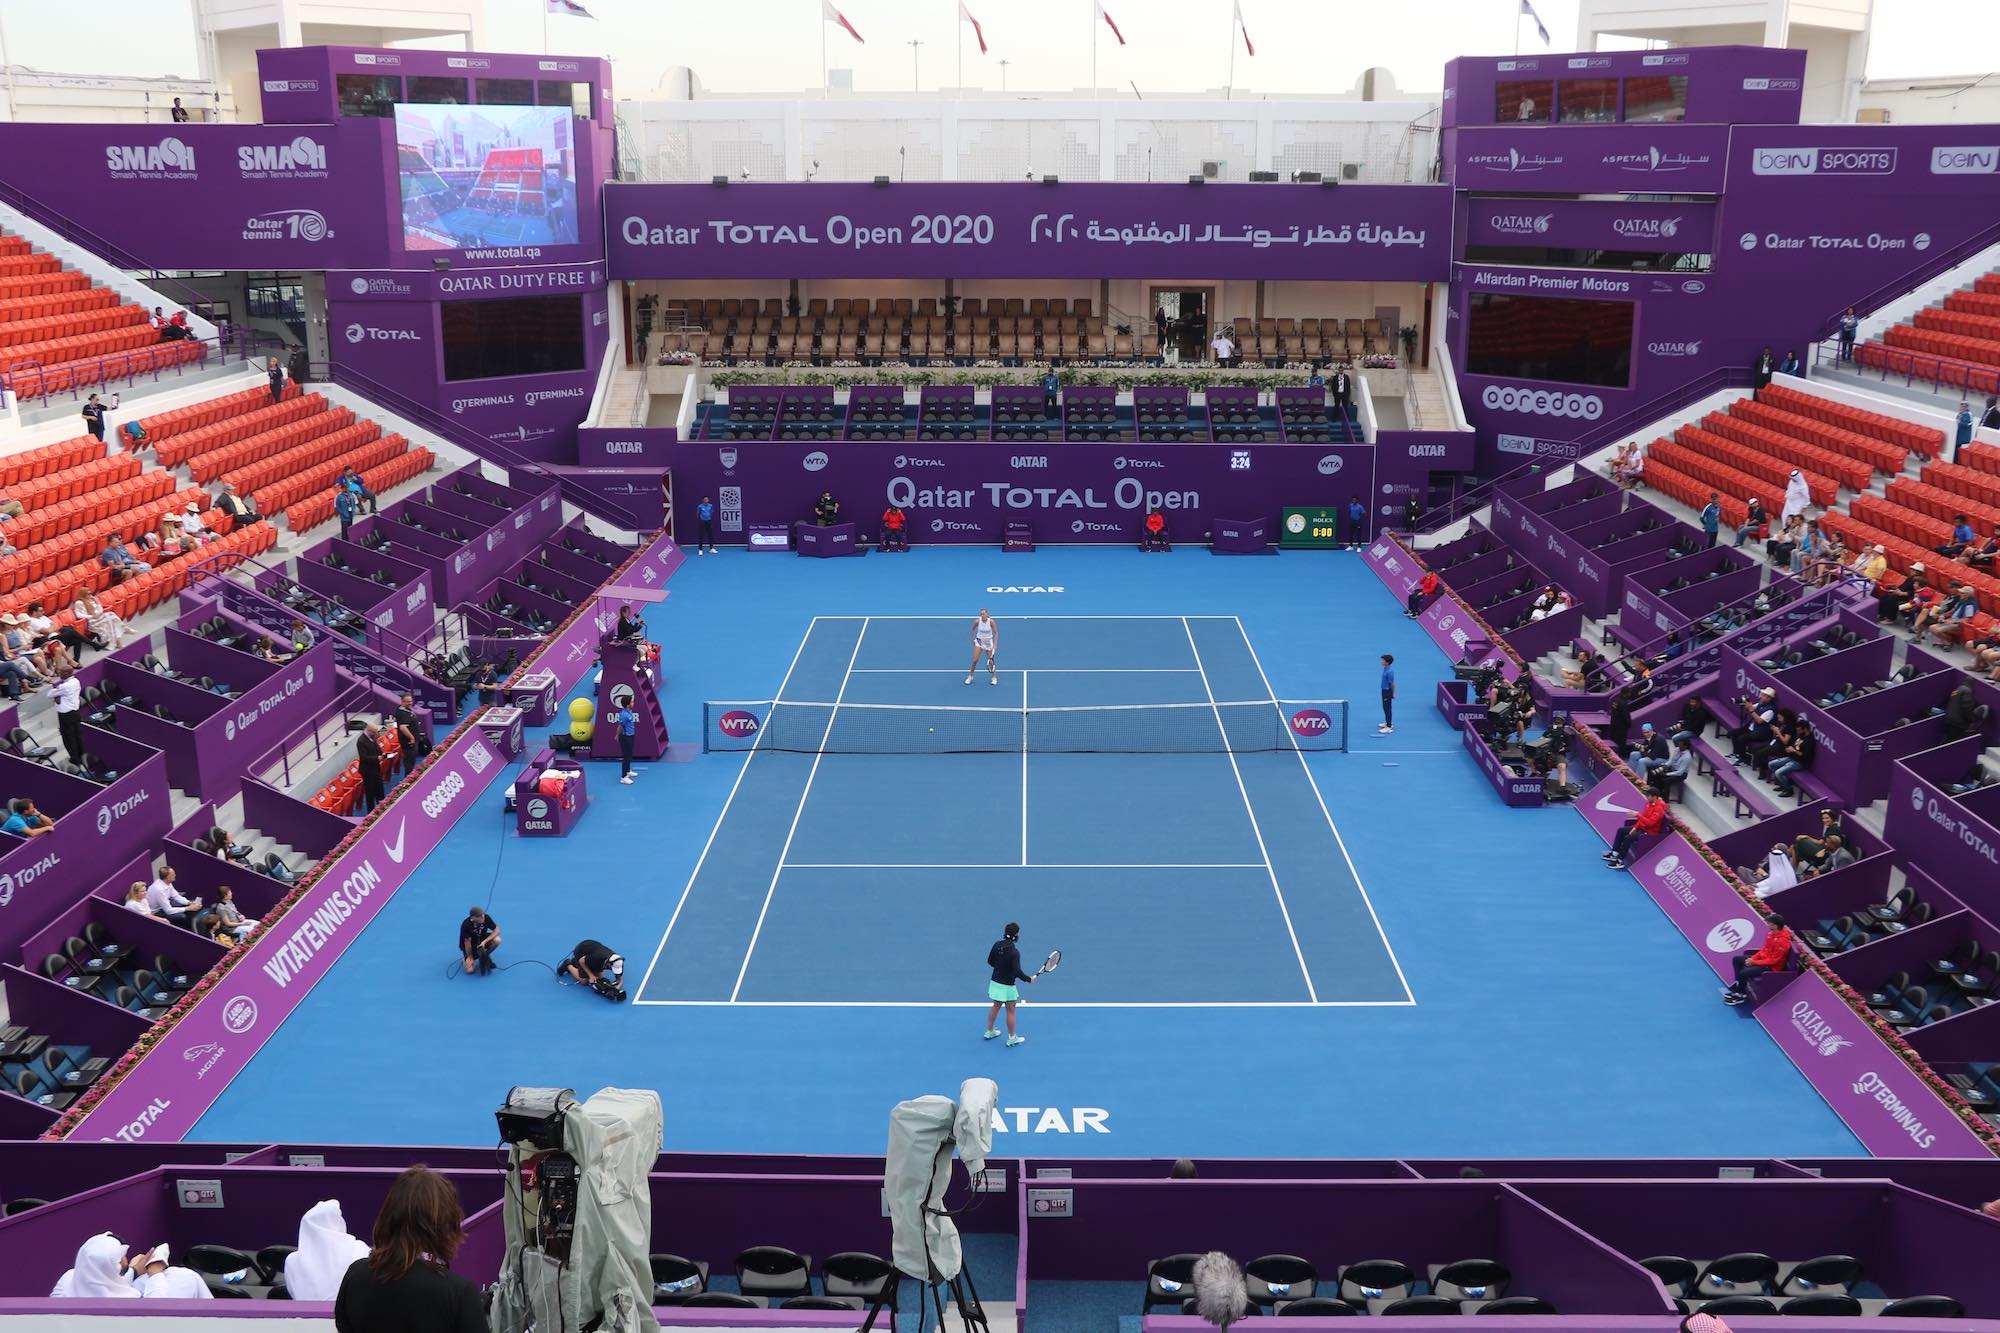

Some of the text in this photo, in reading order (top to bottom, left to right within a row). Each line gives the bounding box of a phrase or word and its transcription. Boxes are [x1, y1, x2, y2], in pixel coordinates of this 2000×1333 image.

[1468, 155, 1509, 163] ASPETAR
[1602, 155, 1649, 163] ASPETAR
[1822, 153, 1889, 169] SPORTS
[111, 170, 198, 181] Smash Tennis Academy
[242, 170, 329, 179] Smash Tennis Academy
[247, 217, 284, 231] Qatar
[1491, 215, 1532, 229] QATAR
[1613, 219, 1659, 233] QATAR
[242, 229, 283, 240] tennis
[622, 214, 994, 249] Qatar TOTAL Open 2020
[1086, 219, 1191, 245] المفتوحة
[1303, 224, 1353, 247] قطر
[1356, 222, 1426, 248] بطولة
[1765, 233, 1804, 249] Qatar
[1867, 233, 1905, 250] Open
[465, 246, 541, 261] www.total.qa
[369, 278, 395, 286] QATAR
[369, 285, 411, 293] DUTY FREE
[440, 272, 585, 293] QATAR DUTY FREE
[1474, 272, 1629, 292] Alfardan Premier Motors
[367, 327, 421, 340] TOTAL
[1648, 342, 1684, 354] QATAR
[452, 394, 514, 414] QTERMINALS
[525, 388, 584, 406] QTERMINALS
[1483, 385, 1603, 420] ooredoo
[606, 441, 642, 454] QATAR
[1409, 445, 1446, 457] QATAR
[1537, 443, 1576, 457] SPORTS
[805, 457, 826, 465] WTA
[909, 458, 945, 466] TOTAL
[1010, 456, 1047, 468] QATAR
[1129, 459, 1165, 468] TOTAL
[1231, 457, 1250, 469] 3:24
[1320, 460, 1341, 469] WTA
[887, 476, 1199, 514] Qatar TOTAL Open
[722, 511, 740, 521] QTF
[946, 521, 981, 531] TOTAL
[1085, 522, 1122, 532] TOTAL
[1313, 527, 1333, 537] 0:00
[237, 710, 258, 730] Qatar
[285, 675, 305, 698] Open
[606, 712, 640, 723] QAR
[721, 718, 757, 730] WTA
[1293, 717, 1329, 729] WTA
[422, 770, 465, 818] ooredoo
[1512, 784, 1541, 794] QATAR
[111, 788, 149, 820] TOTAL
[1928, 799, 1956, 832] Qatar
[525, 821, 552, 830] QATAR
[14, 852, 60, 887] TOTAL
[1675, 865, 1696, 888] QATAR
[1665, 872, 1686, 892] DUTY
[1680, 887, 1698, 905] FREE
[262, 859, 382, 988] WTATENNIS.COM
[1717, 922, 1743, 950] WTA
[227, 1002, 245, 1022] LAND
[1792, 1001, 1832, 1041] QATAR
[196, 1047, 226, 1079] JAGUAR
[1852, 1071, 1936, 1149] QTERMINALS
[200, 1190, 215, 1198] QTF
